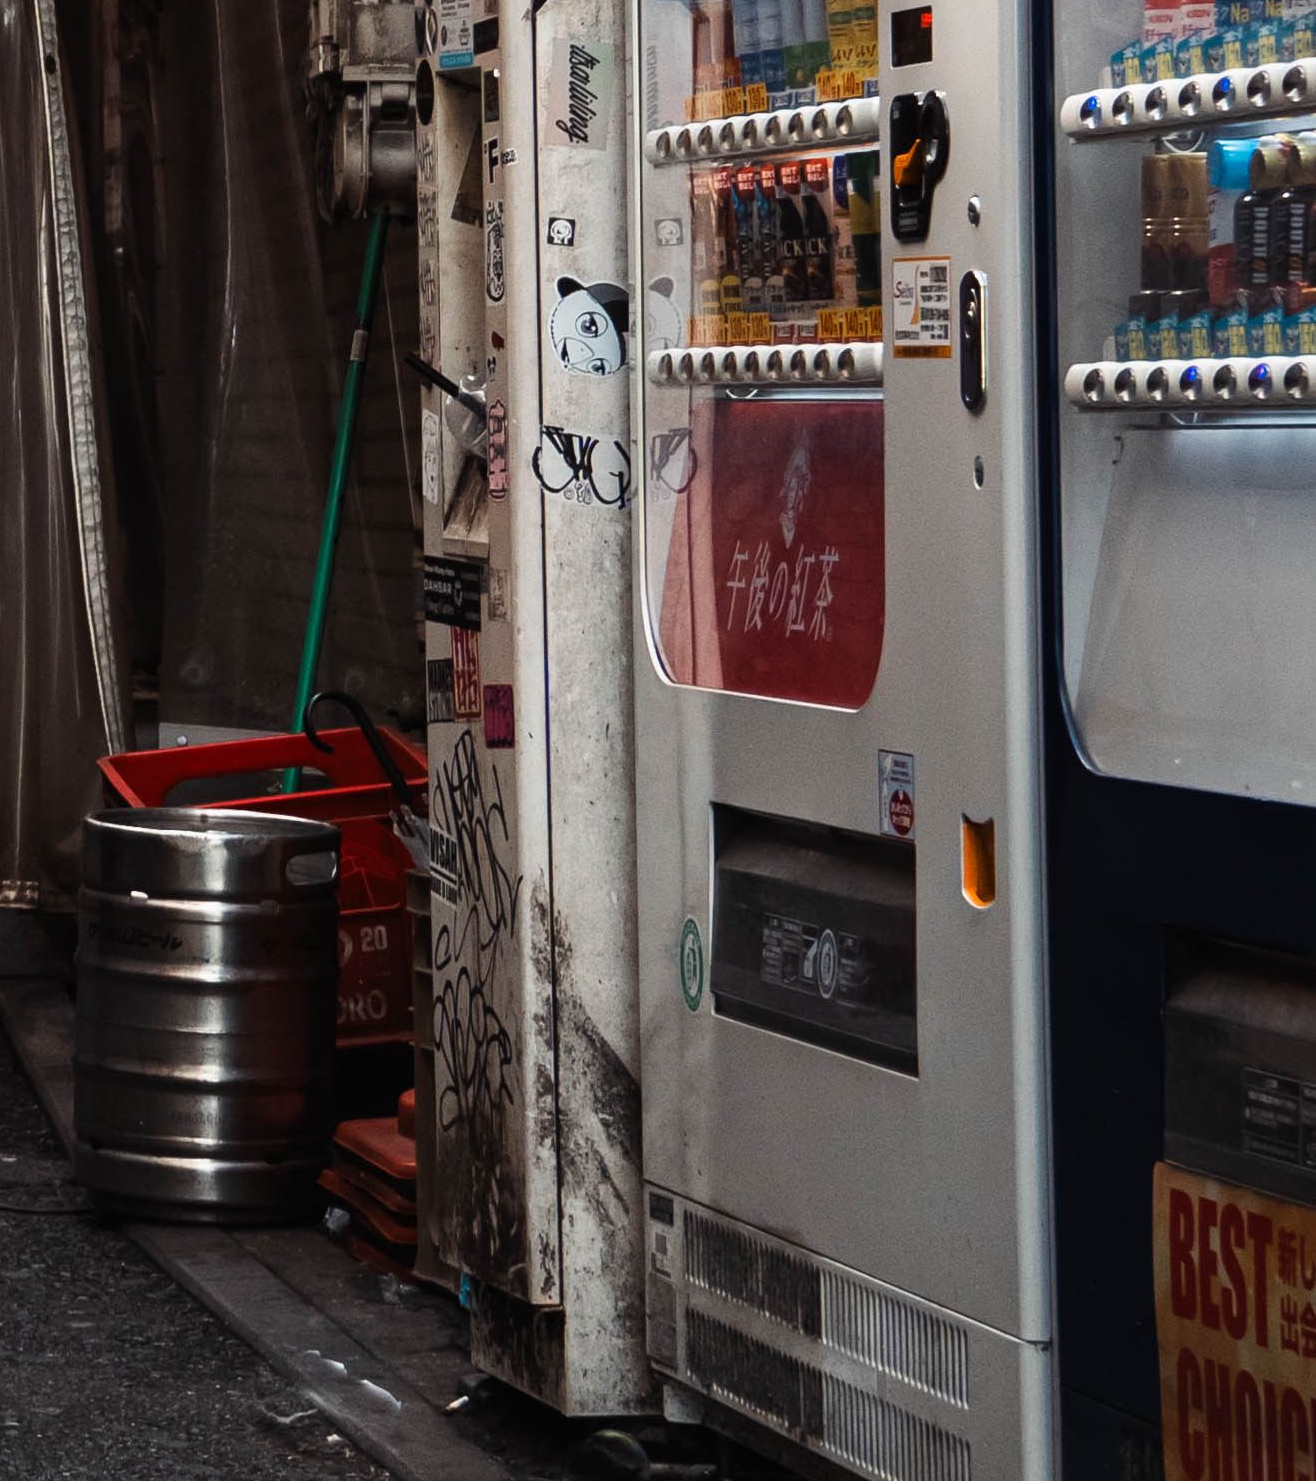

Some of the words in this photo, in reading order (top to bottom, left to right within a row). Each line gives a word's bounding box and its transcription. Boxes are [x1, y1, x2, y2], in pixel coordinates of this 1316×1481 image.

[726, 539, 840, 642] 午後の紅茶
[360, 926, 389, 953] 20
[1169, 1187, 1274, 1350] BEST
